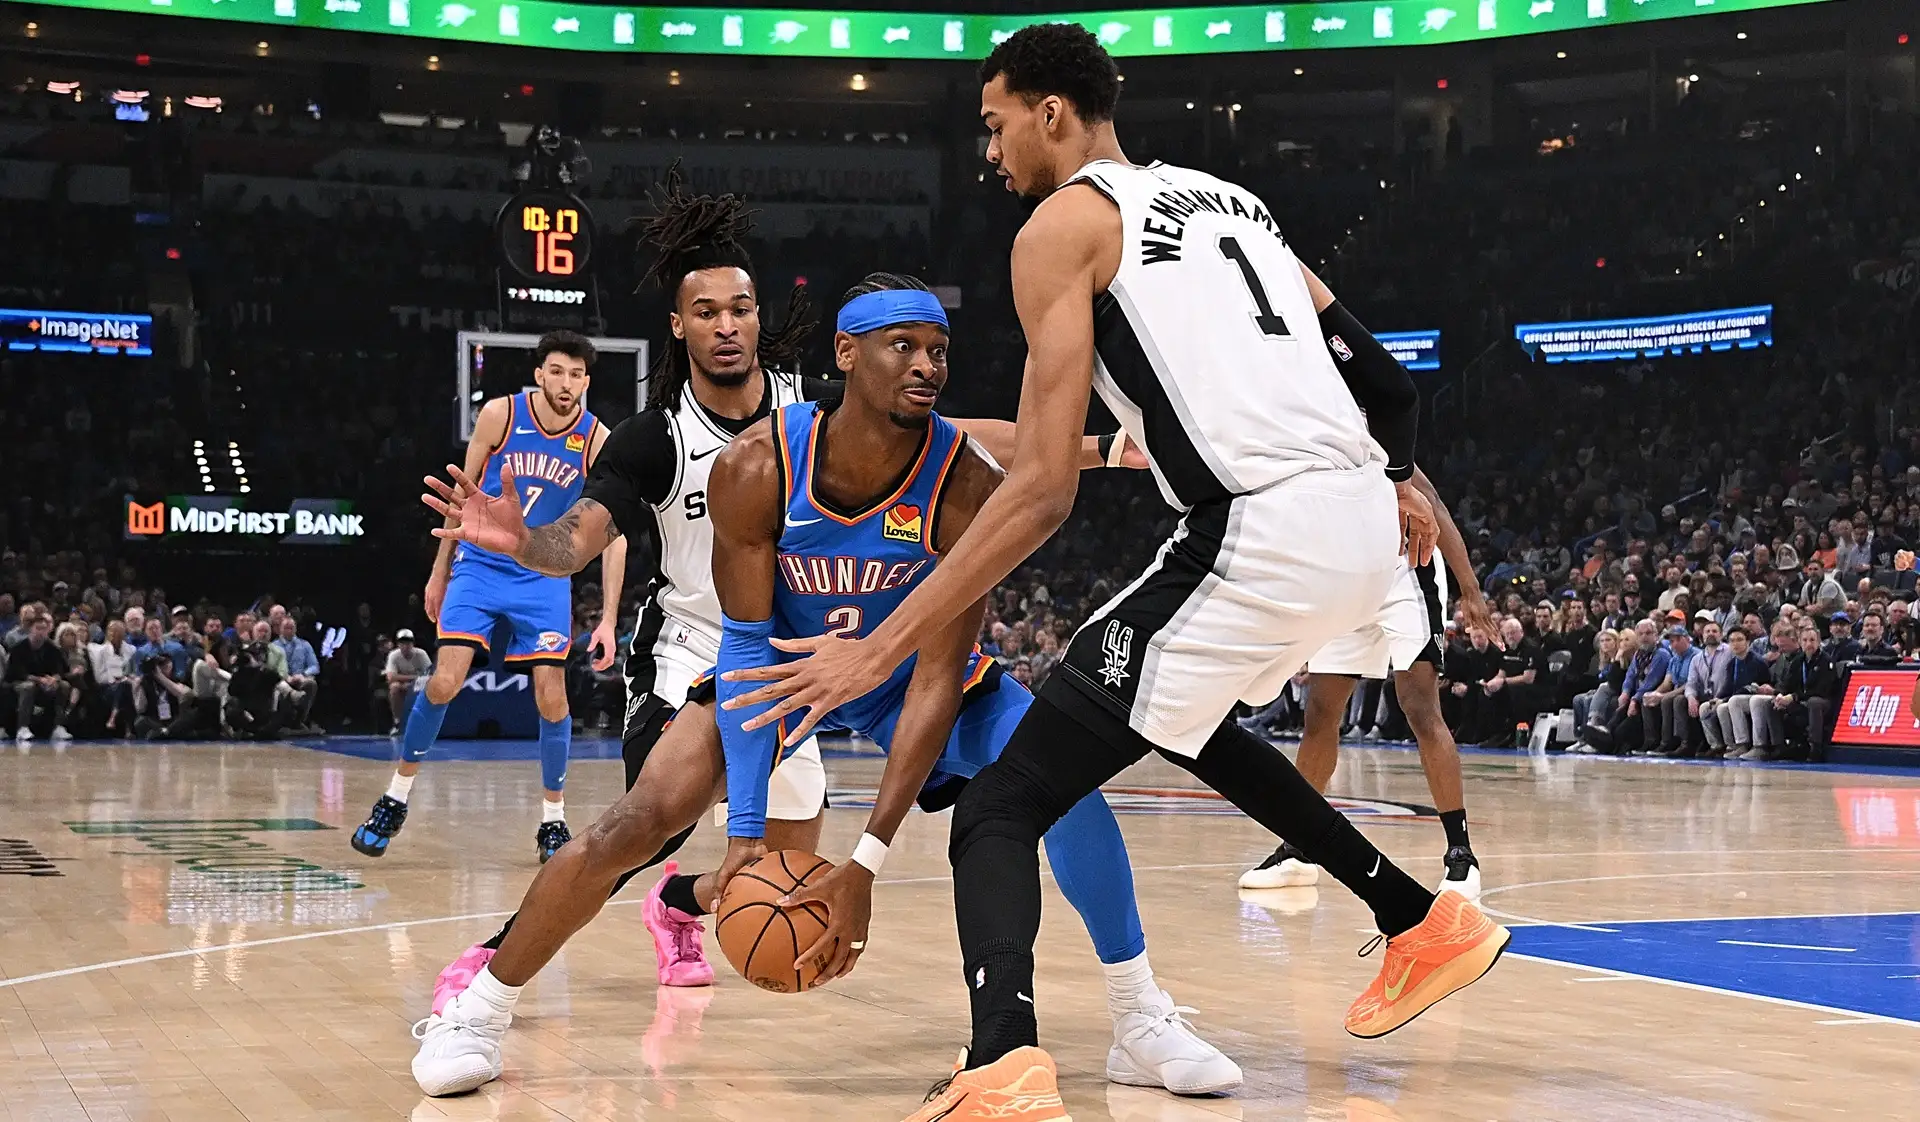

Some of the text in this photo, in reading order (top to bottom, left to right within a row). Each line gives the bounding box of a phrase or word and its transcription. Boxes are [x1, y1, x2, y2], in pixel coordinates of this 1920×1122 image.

[523, 206, 578, 234] 10:17
[536, 231, 573, 275] 16
[529, 287, 586, 304] TISSOT
[1217, 235, 1293, 338] 1
[40, 316, 139, 342] ImageNet
[1524, 333, 1553, 344] OFFICE
[1554, 331, 1580, 342] PRINT
[1580, 328, 1628, 341] SOLUTIONS
[1633, 323, 1676, 338] DOCUMENT
[1683, 320, 1717, 333] PROCESS
[1716, 315, 1766, 329] AUTOMATION
[1540, 341, 1580, 354] MANAGED
[1580, 341, 1591, 352] IT
[1668, 332, 1704, 345] PRINTERS
[1711, 327, 1751, 341] SCANNERS
[504, 452, 580, 489] THUNDER
[523, 484, 545, 518] 7
[776, 552, 928, 595] THUNDER
[824, 605, 864, 641] 2
[1861, 686, 1900, 734] App
